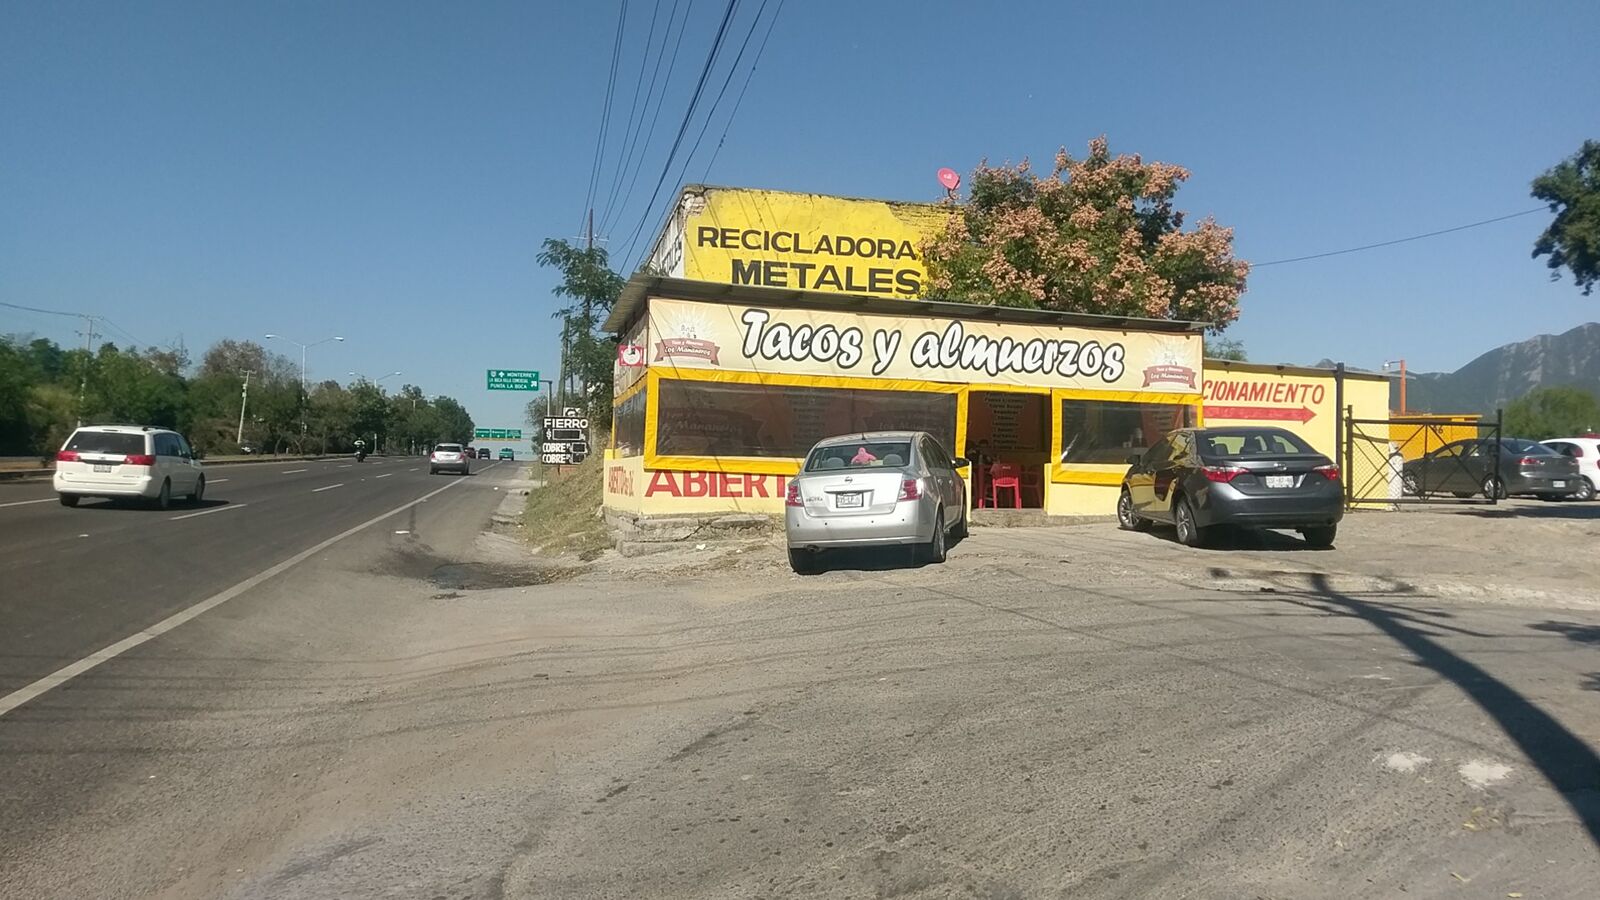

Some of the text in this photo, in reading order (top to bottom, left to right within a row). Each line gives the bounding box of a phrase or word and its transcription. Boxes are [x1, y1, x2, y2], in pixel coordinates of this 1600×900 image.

[697, 226, 918, 261] RECICLADORA
[731, 258, 922, 295] METALES
[741, 307, 1126, 384] Tacos y almuerzos
[1203, 379, 1325, 405] CIONAMIENTO
[543, 418, 589, 429] FIERRO
[542, 442, 566, 453] COBRE
[542, 453, 566, 464] COBRE
